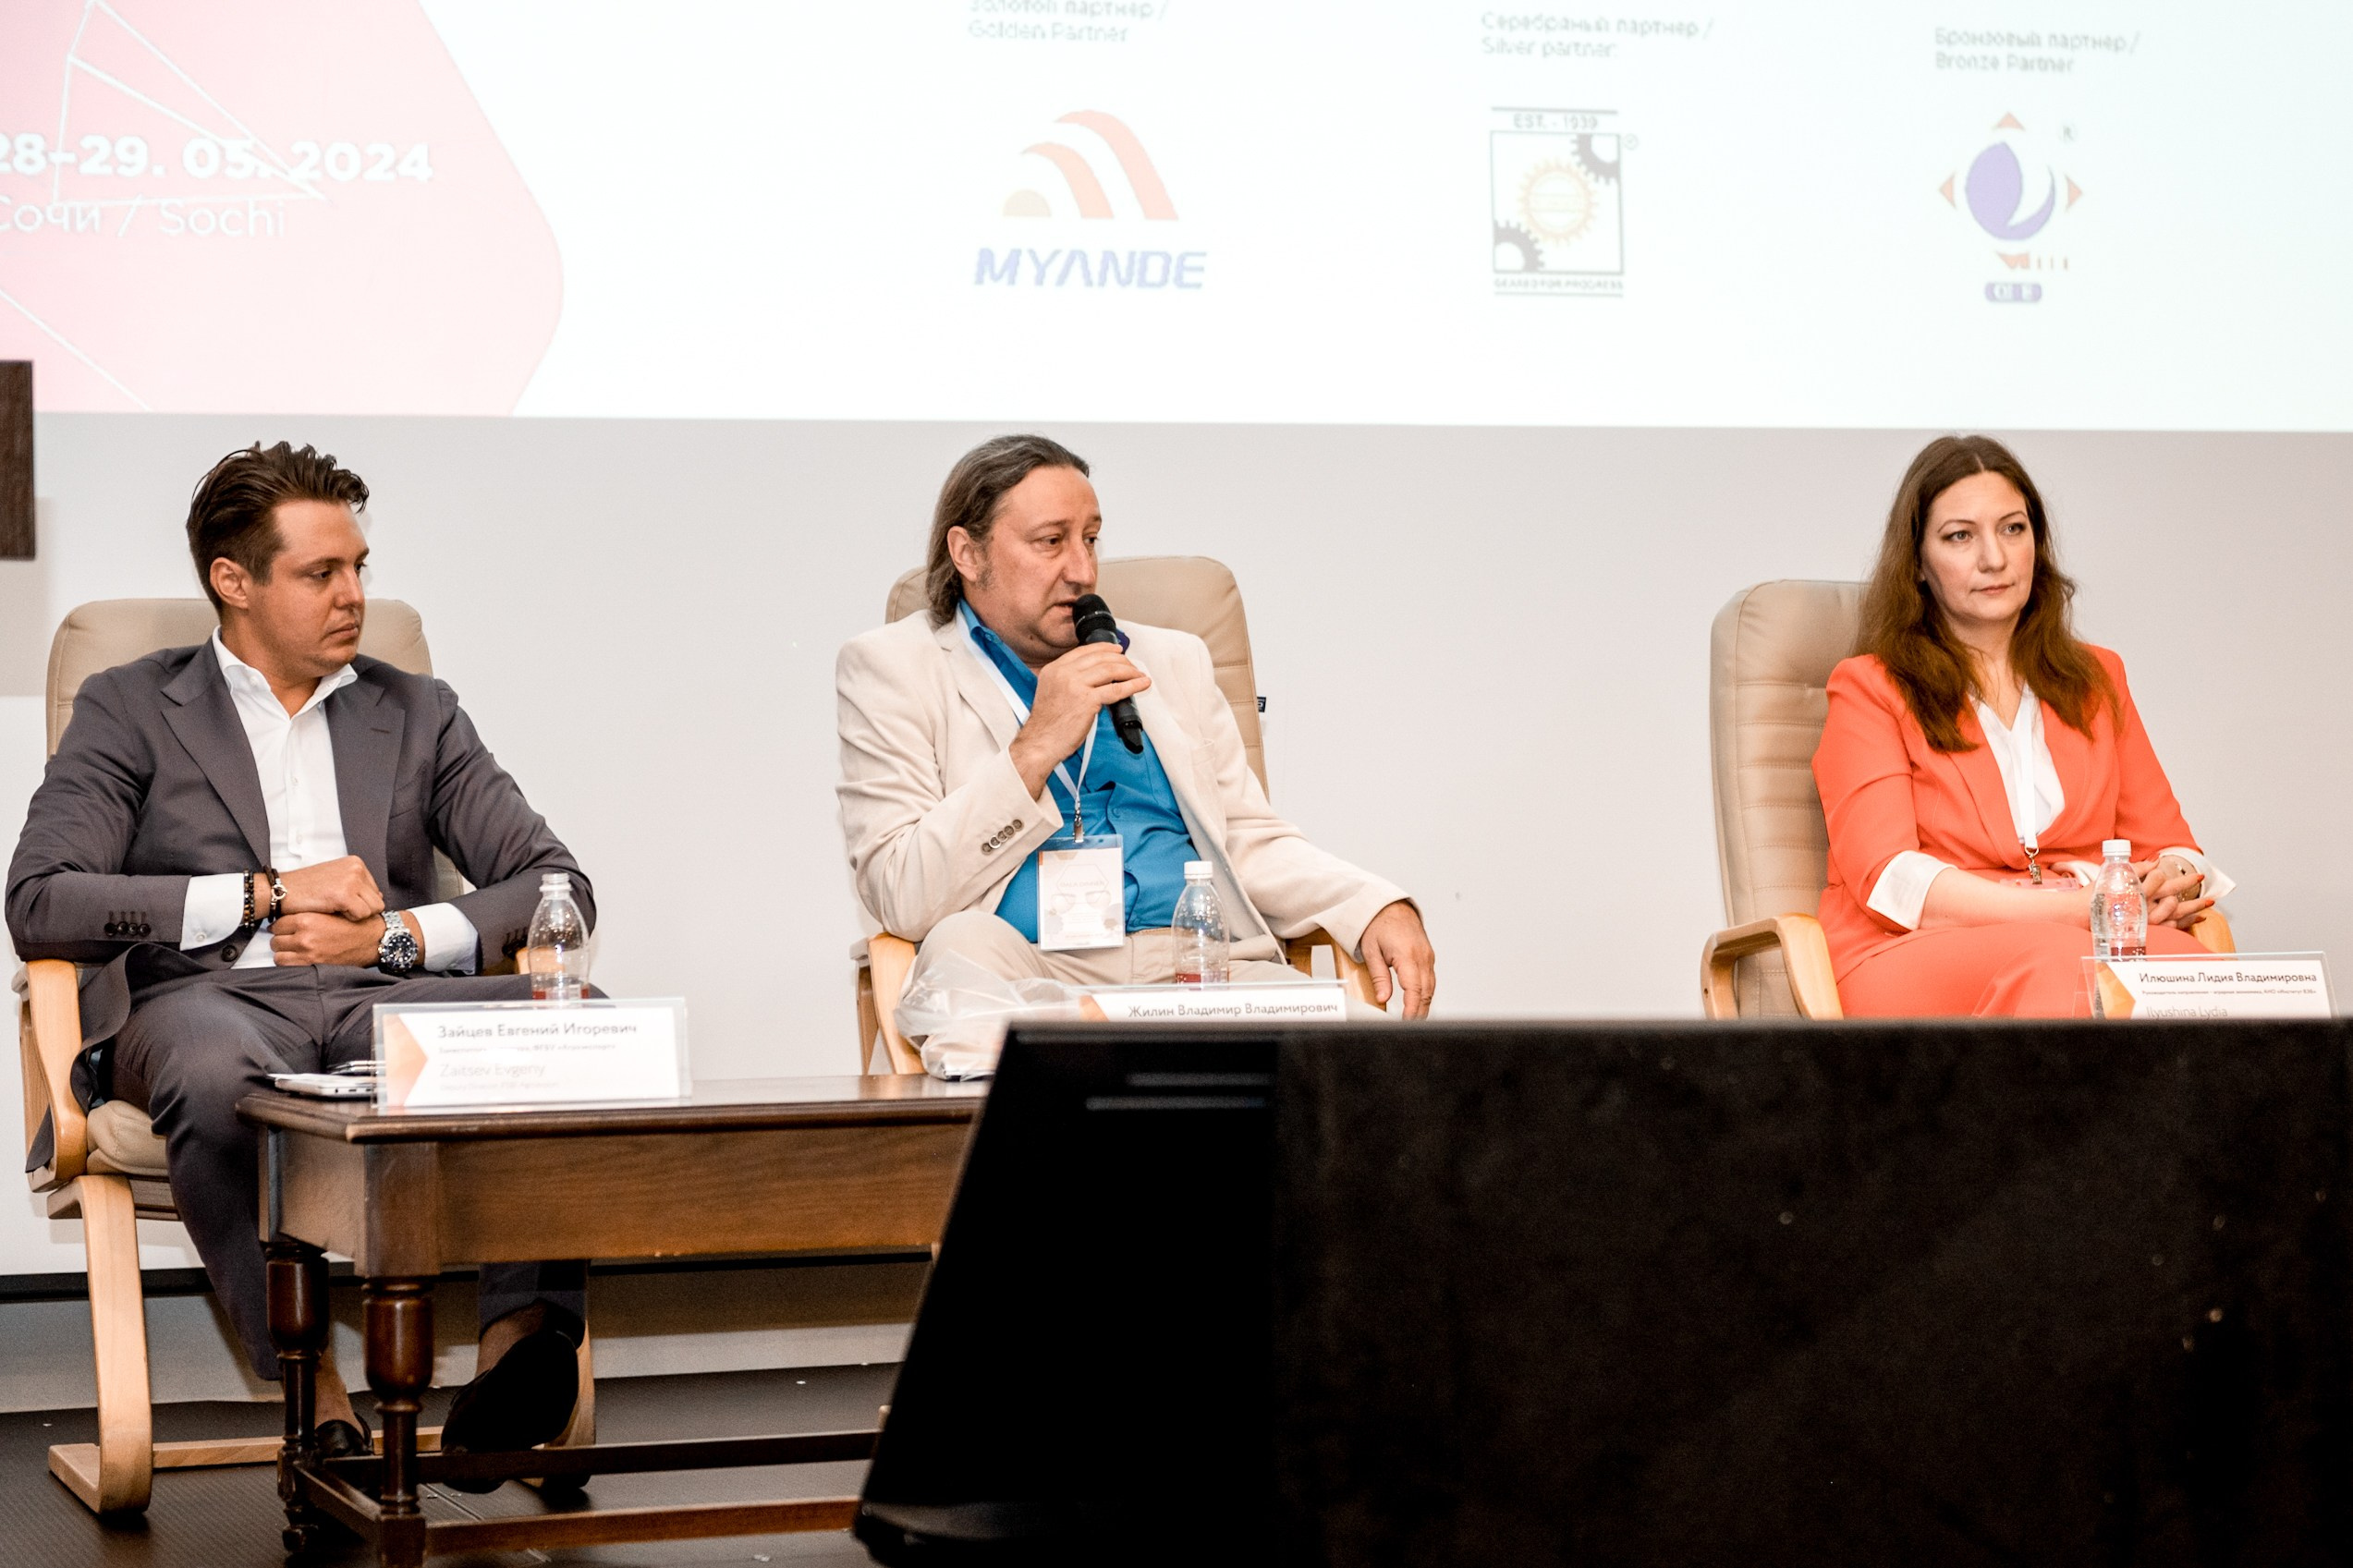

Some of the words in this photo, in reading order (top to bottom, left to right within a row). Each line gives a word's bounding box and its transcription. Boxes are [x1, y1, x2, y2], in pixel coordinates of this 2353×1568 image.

[969, 19, 1046, 40] Golden
[1051, 22, 1129, 43] Partner
[1481, 37, 1536, 55] Silver
[1935, 51, 2000, 71] Bronze
[2006, 54, 2075, 73] Partner
[1564, 115, 1598, 130] 1939
[289, 140, 433, 182] 2024
[160, 201, 286, 237] Sochi
[974, 247, 1208, 289] MYANDE
[2140, 973, 2195, 983] Илюшина
[2199, 973, 2234, 983] Лидия
[2237, 972, 2317, 984] Владимировна
[1128, 1004, 1175, 1017] Жилин
[1177, 1003, 1241, 1017] Владимир
[1245, 1003, 1338, 1016] Владимирович
[438, 1025, 493, 1039] Зайцев
[498, 1023, 559, 1037] Евгений
[564, 1022, 638, 1039] Игоревич
[440, 1063, 491, 1078] Zaitsev
[495, 1063, 546, 1078] Evgeny
